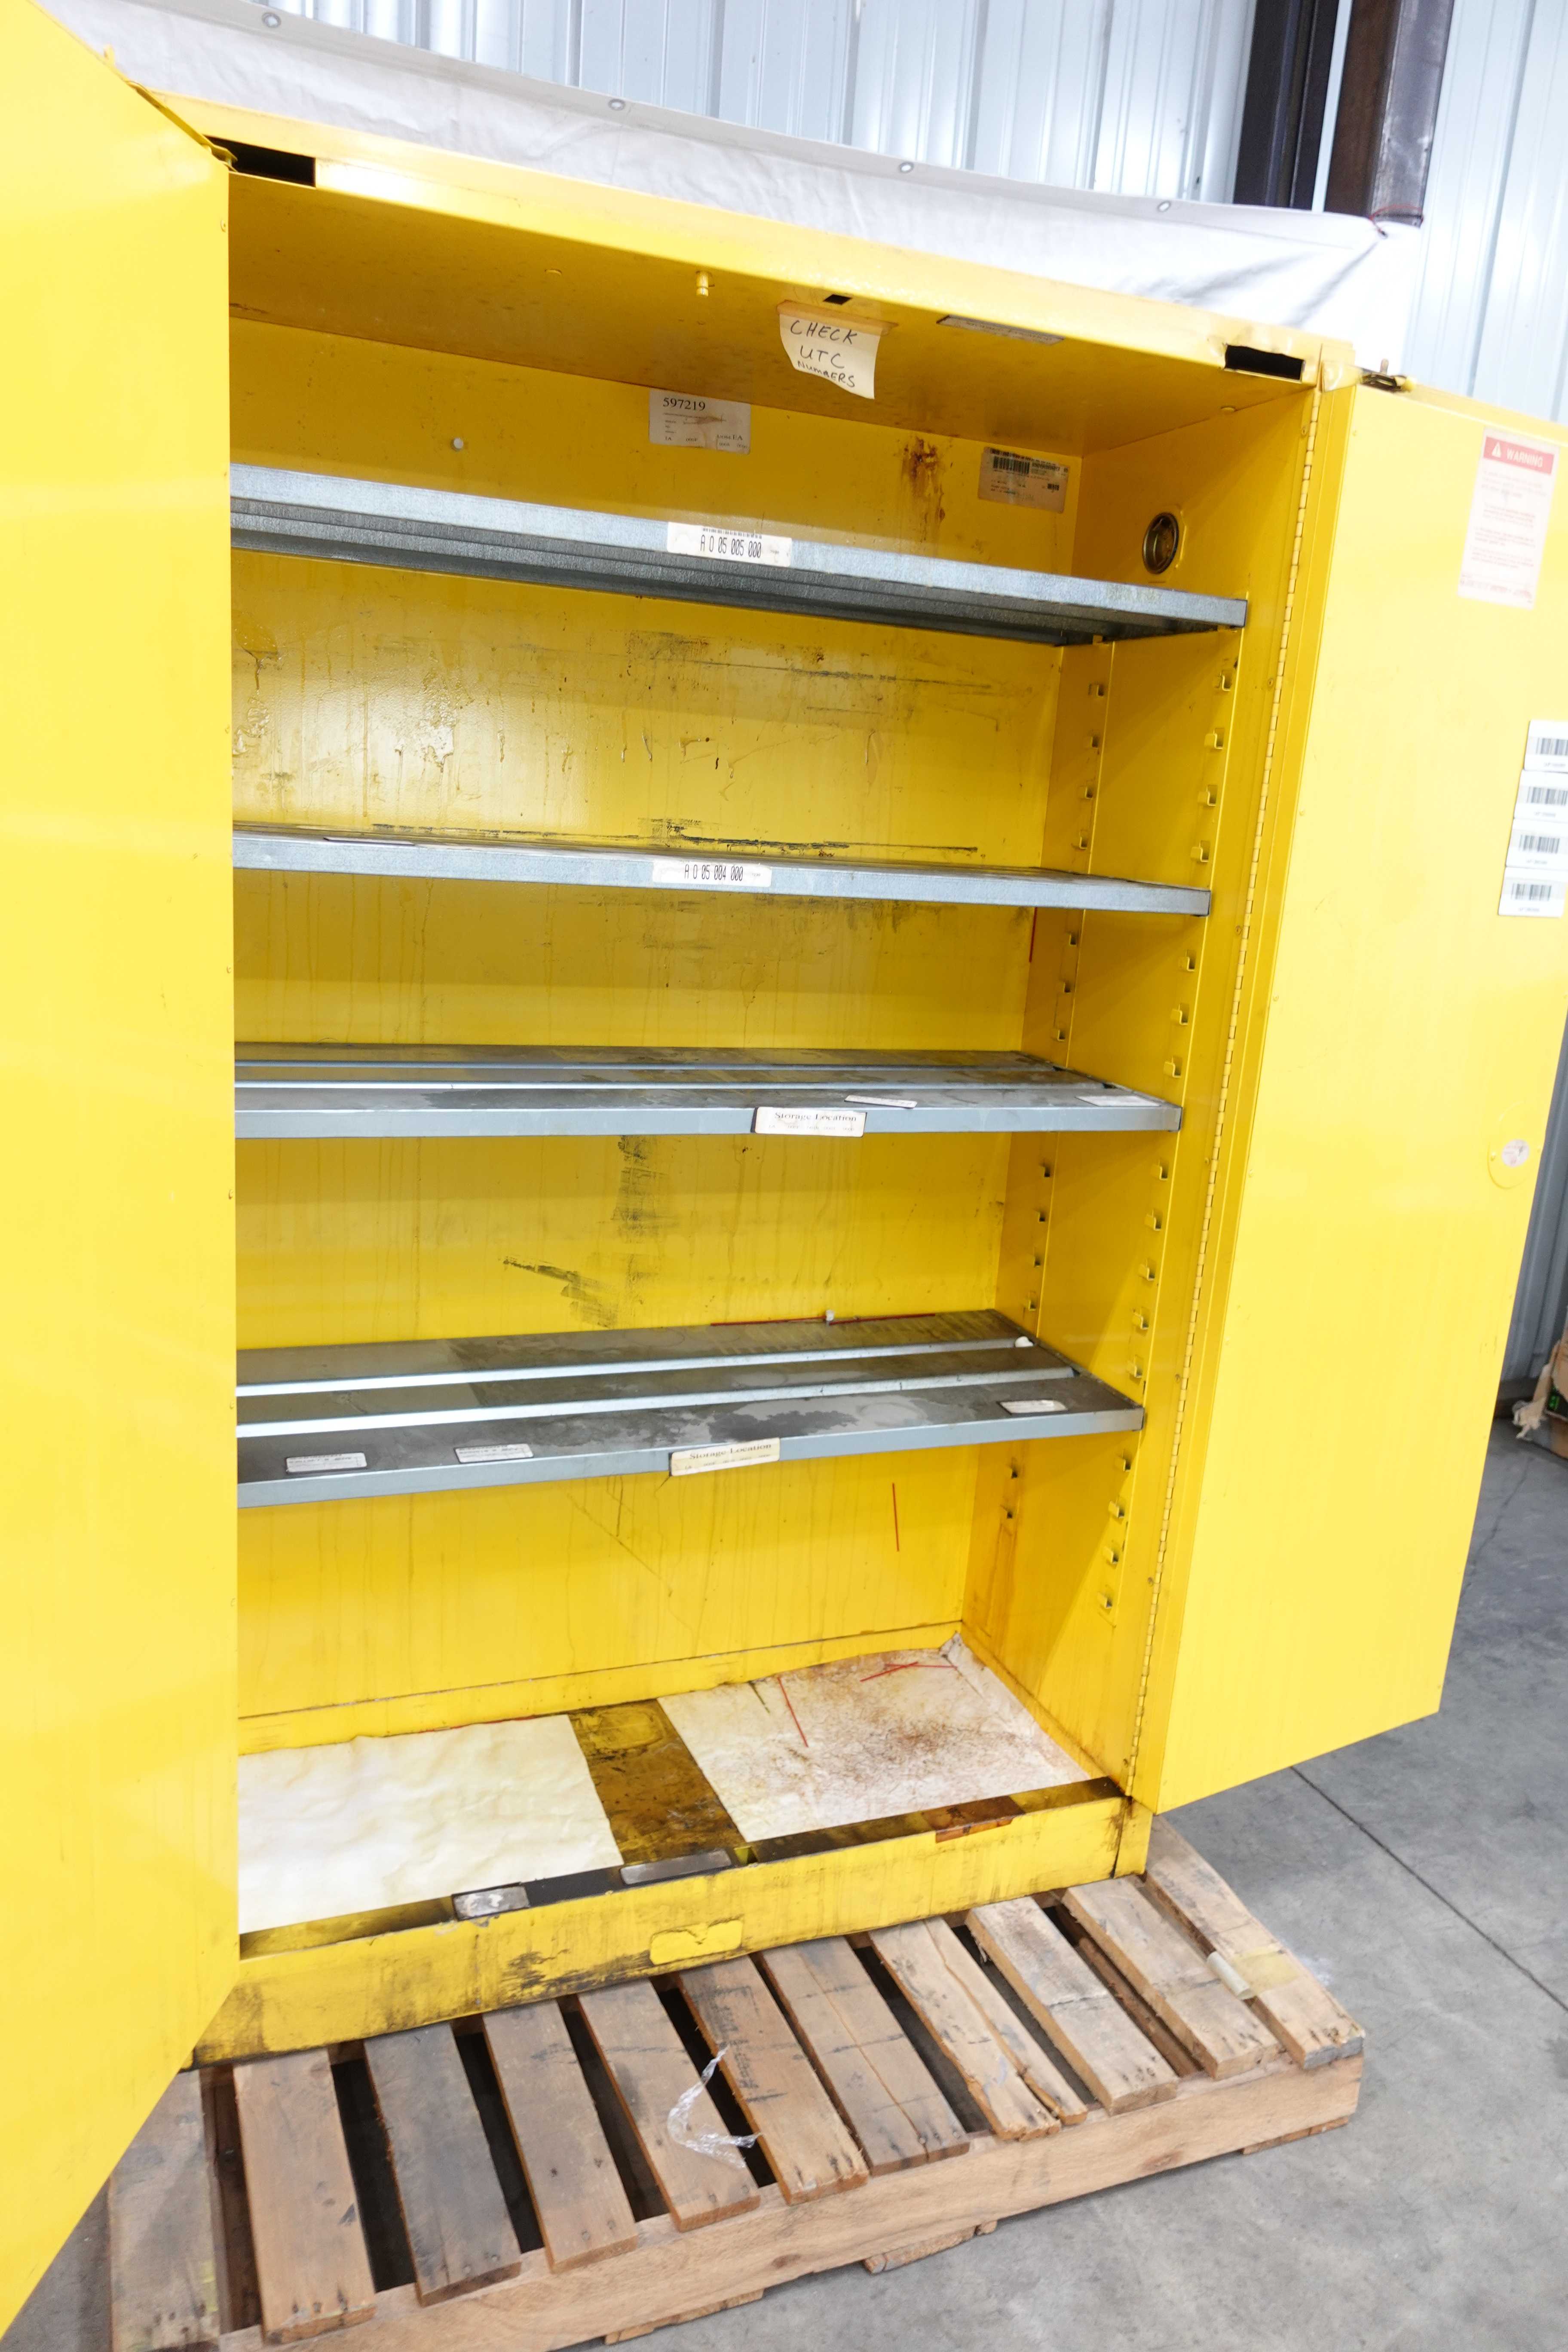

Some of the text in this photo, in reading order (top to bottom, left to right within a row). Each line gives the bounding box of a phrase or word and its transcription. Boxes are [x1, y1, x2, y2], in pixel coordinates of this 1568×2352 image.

[790, 319, 858, 345] CHECK
[800, 345, 845, 369] UTC
[663, 397, 706, 411] 597219
[1506, 448, 1543, 468] WARNING
[700, 534, 706, 551] A
[718, 537, 727, 554] 05
[731, 538, 744, 556] 005
[748, 541, 762, 558] 000
[684, 864, 690, 879] A
[701, 864, 710, 880] 05
[714, 865, 727, 881] 004
[731, 866, 744, 882] 000
[774, 1112, 857, 1122] Storage Location
[689, 1444, 772, 1460] Storage Location
